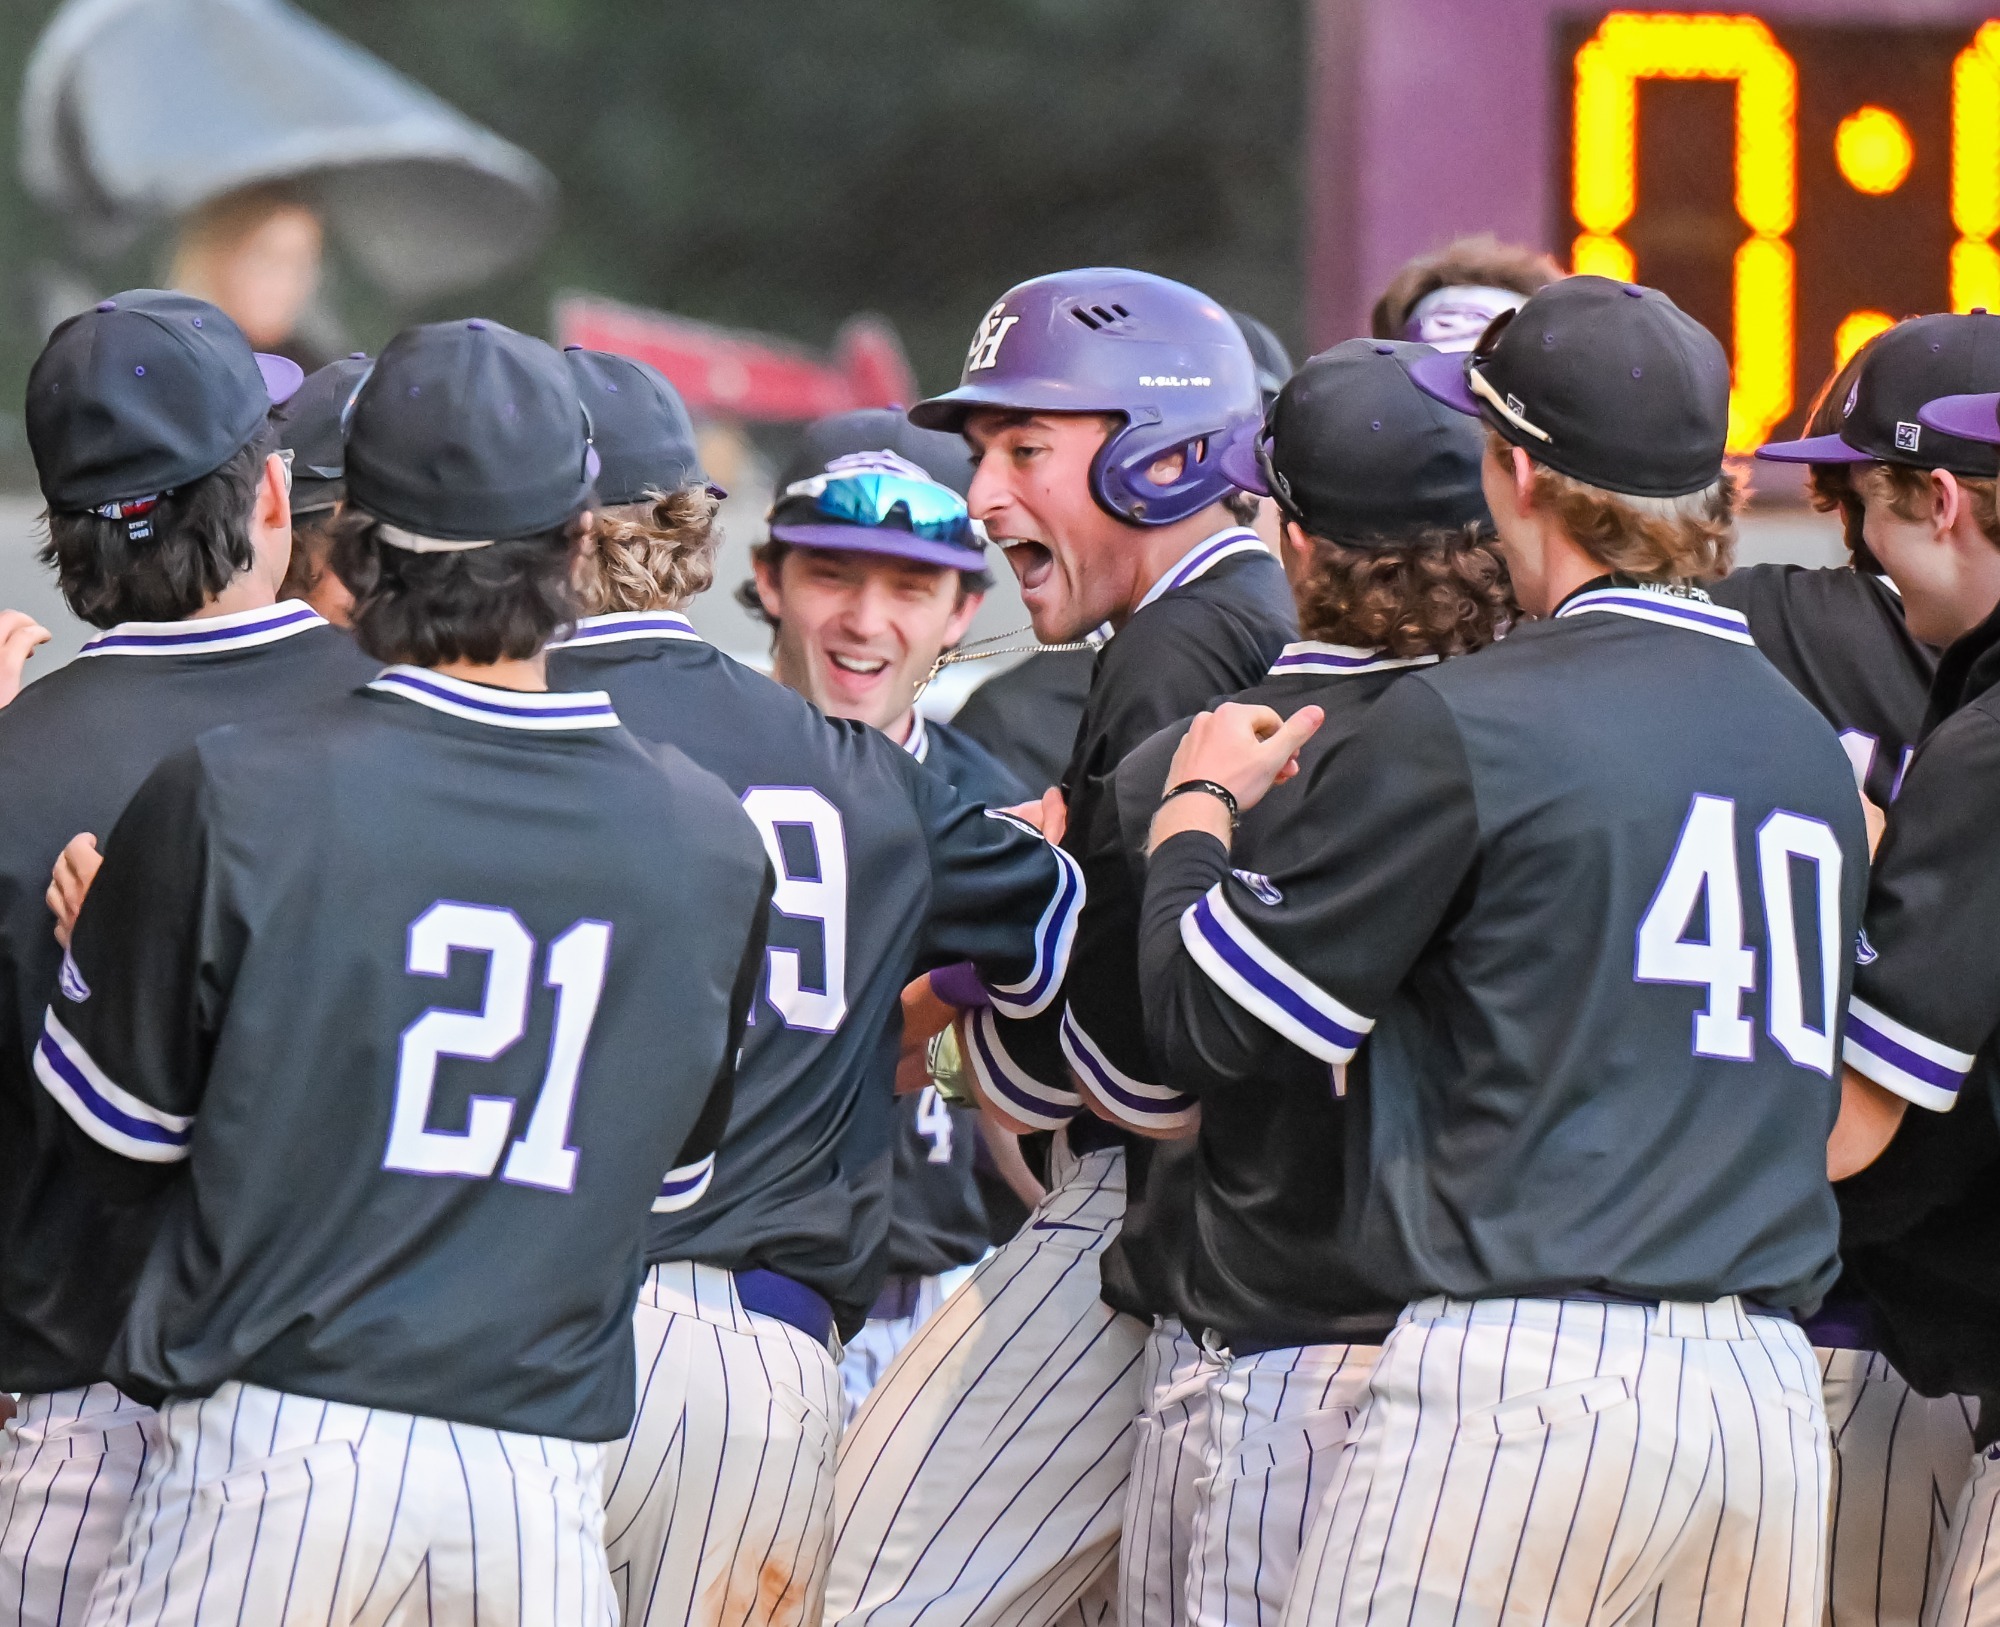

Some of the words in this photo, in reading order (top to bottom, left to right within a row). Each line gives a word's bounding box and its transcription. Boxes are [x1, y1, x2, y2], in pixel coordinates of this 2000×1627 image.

[1638, 582, 1687, 599] NIKE
[1688, 586, 1715, 606] PR
[739, 785, 849, 1035] 9
[1633, 792, 1843, 1079] 40
[381, 900, 613, 1193] 21
[916, 1084, 954, 1164] 4
